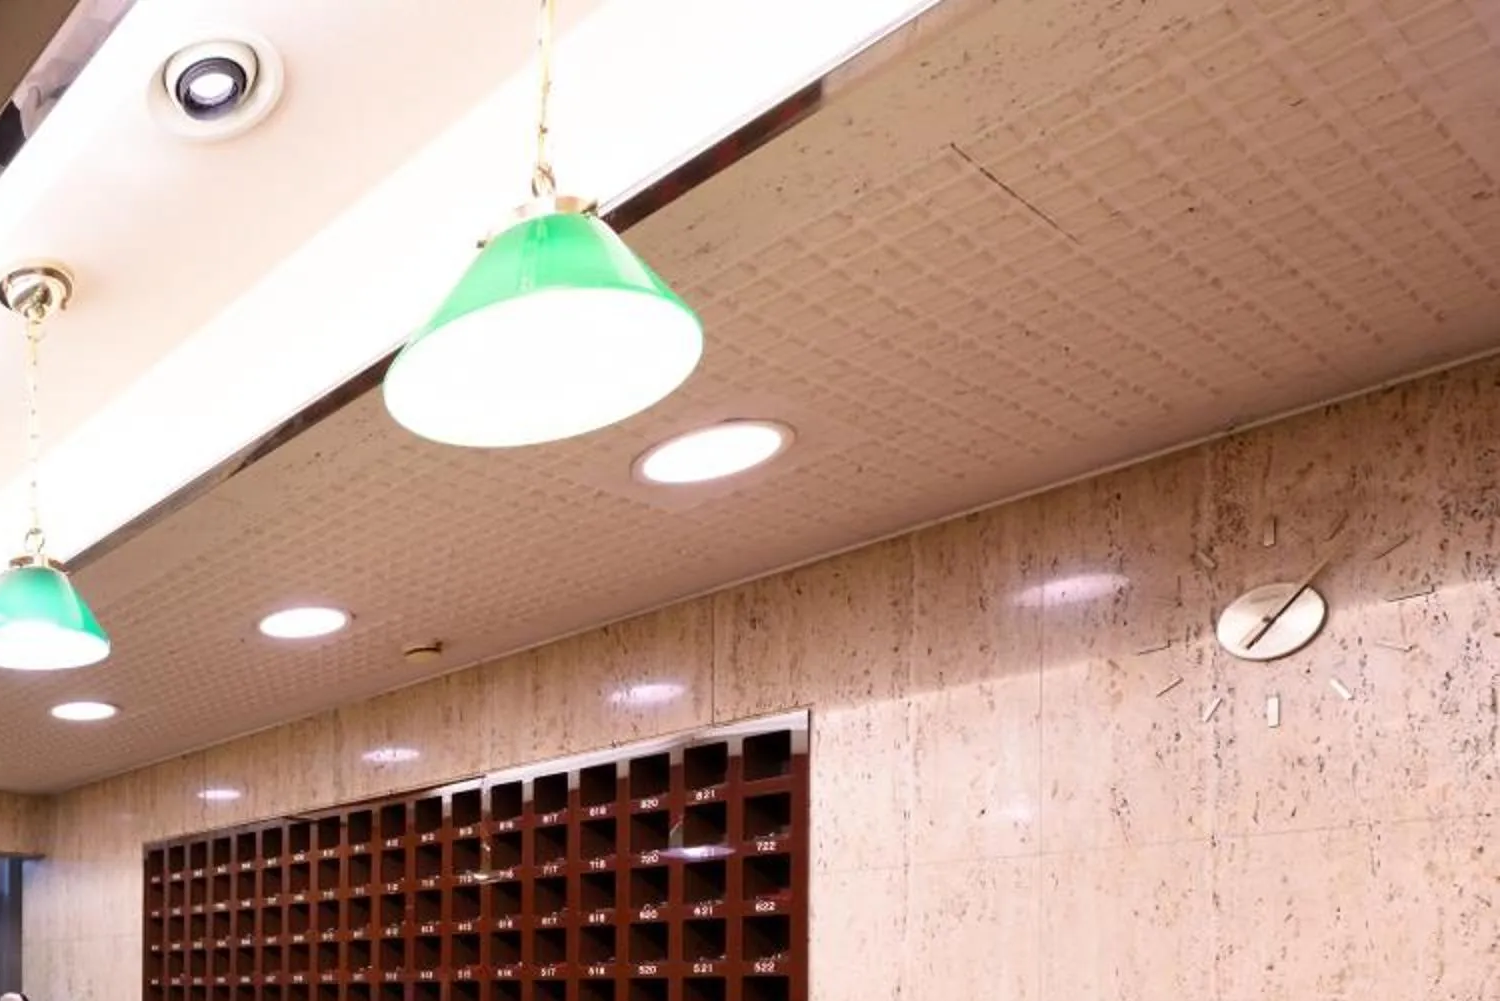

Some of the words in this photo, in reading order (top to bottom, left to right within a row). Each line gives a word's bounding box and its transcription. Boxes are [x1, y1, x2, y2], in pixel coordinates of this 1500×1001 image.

[695, 790, 715, 800] 821
[756, 841, 777, 851] 722
[693, 906, 713, 916] 621
[755, 902, 776, 912] 622
[638, 965, 657, 975] 520
[693, 963, 713, 973] 521
[754, 961, 775, 972] 522
